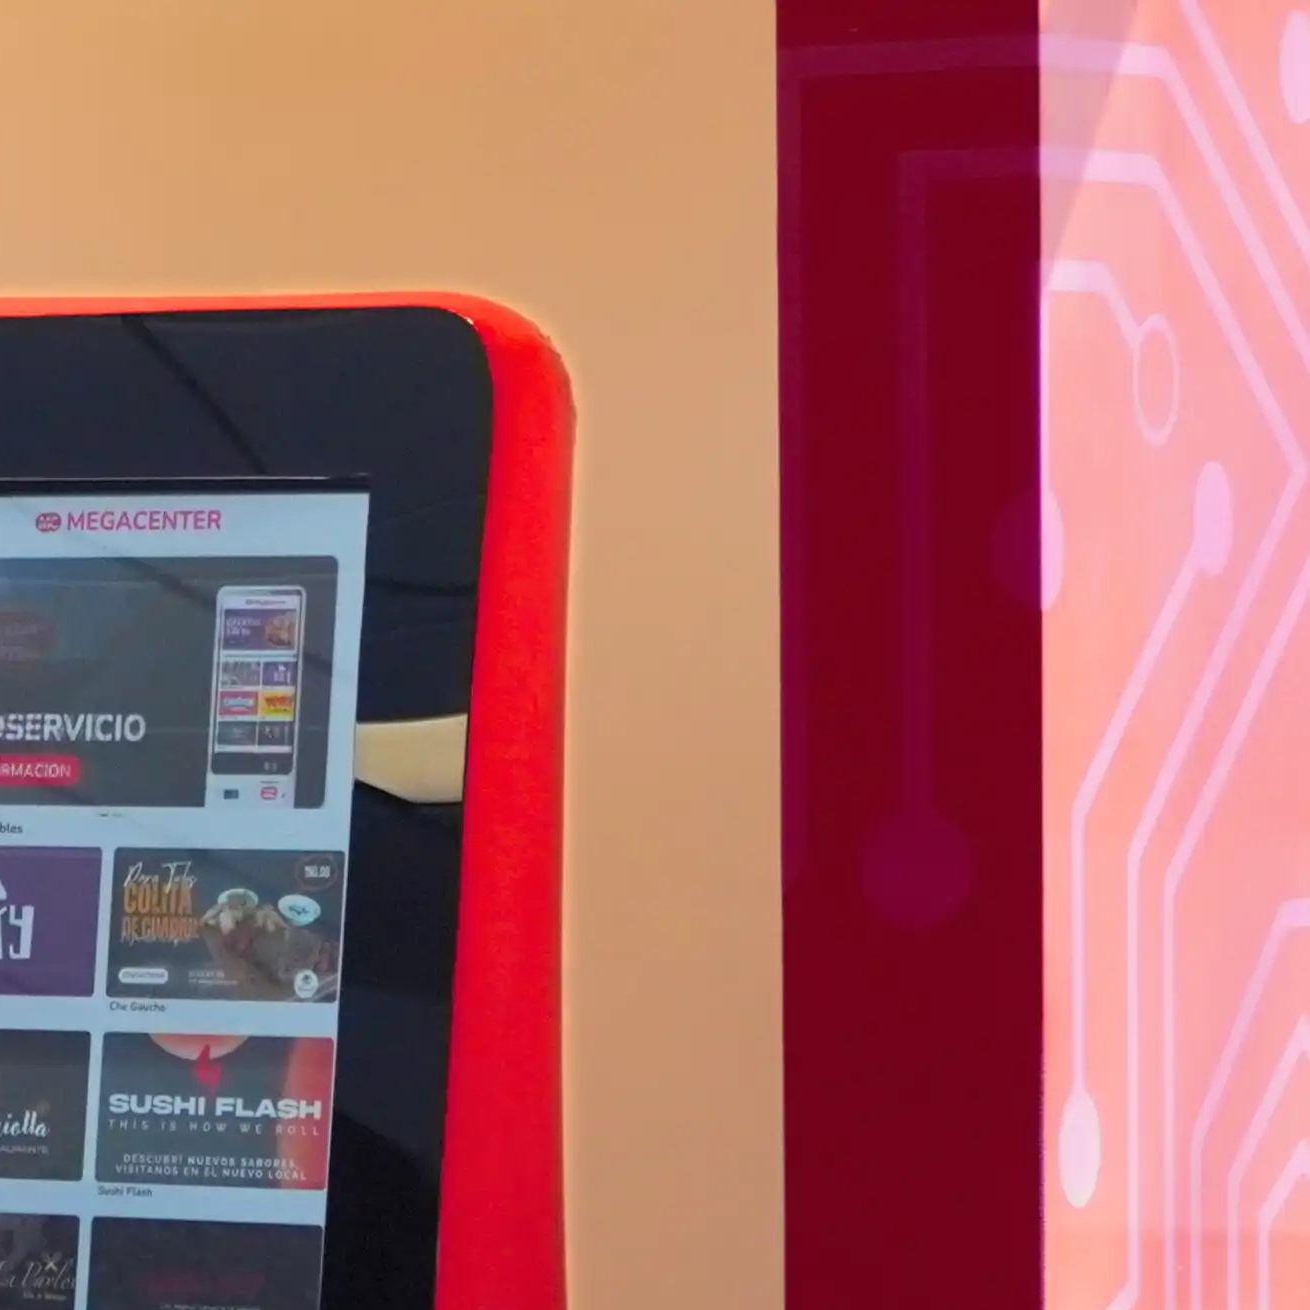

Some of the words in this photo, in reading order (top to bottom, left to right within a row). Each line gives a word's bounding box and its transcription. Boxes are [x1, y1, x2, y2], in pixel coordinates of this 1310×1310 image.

[67, 510, 222, 531] MEGACENTER
[109, 1001, 127, 1011] Che
[130, 1002, 166, 1013] Gaucho
[109, 1094, 205, 1116] SUSHI
[216, 1097, 322, 1120] FLASH
[109, 1118, 149, 1130] THIS
[161, 1120, 177, 1131] IS
[190, 1121, 227, 1132] HOW
[240, 1123, 263, 1135] WE
[276, 1125, 320, 1137] ROLL
[187, 1156, 236, 1167] NUEVOS
[115, 1163, 179, 1176] VISITANOS
[183, 1166, 199, 1177] EN
[204, 1167, 218, 1178] EL
[222, 1168, 263, 1179] NUEVO
[268, 1170, 307, 1181] LOCAL
[98, 1185, 124, 1197] Sushi
[126, 1187, 153, 1199] Flash
